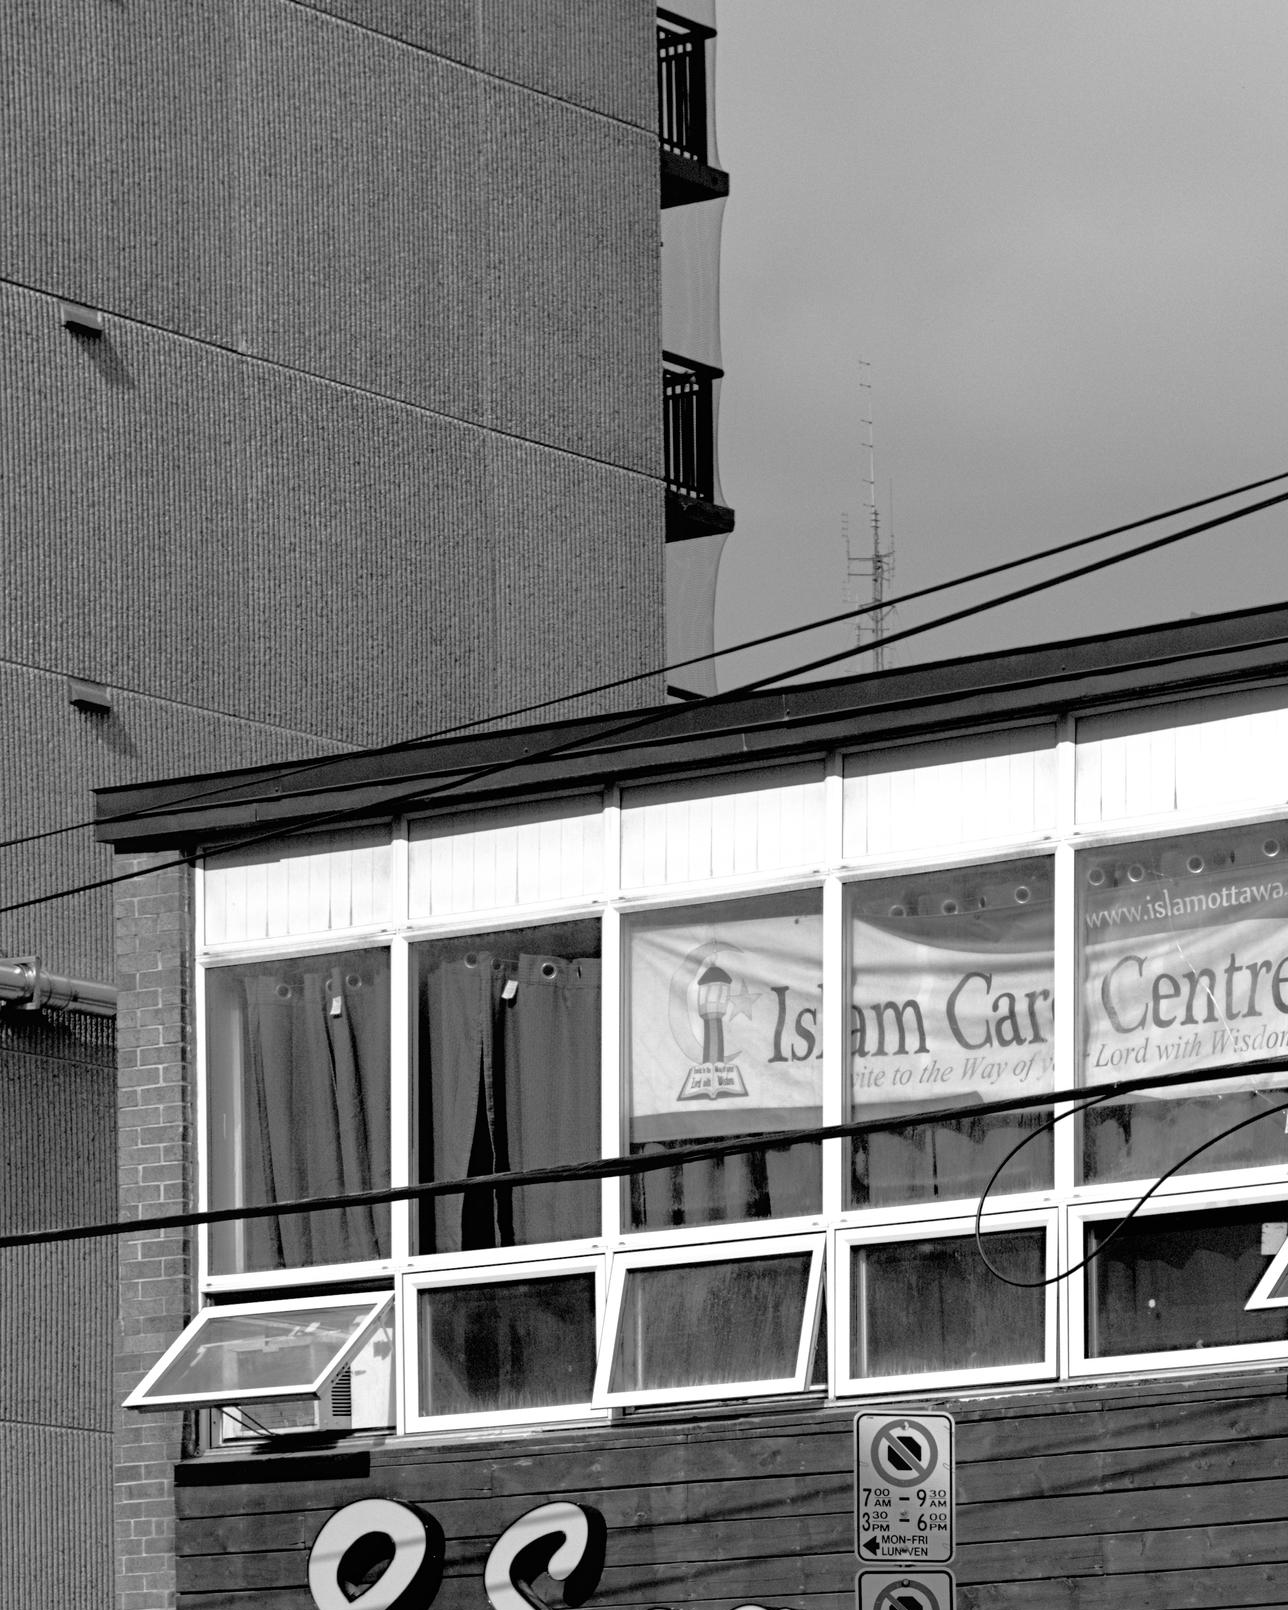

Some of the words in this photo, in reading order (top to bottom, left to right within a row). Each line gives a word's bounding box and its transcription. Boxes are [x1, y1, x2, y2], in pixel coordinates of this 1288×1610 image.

[768, 984, 930, 1063] Isam
[946, 972, 1054, 1050] Car
[892, 1066, 912, 1086] to
[919, 1060, 953, 1084] the
[961, 1056, 1008, 1086] Way
[1012, 1053, 1037, 1082] of
[1095, 1036, 1150, 1068] Lord
[1155, 1033, 1201, 1058] with
[863, 1488, 872, 1507] 7
[874, 1499, 892, 1507] AM
[916, 1489, 927, 1507] 9
[929, 1500, 947, 1508] AM
[862, 1512, 871, 1532] 3
[872, 1524, 890, 1532] PM
[917, 1513, 927, 1531] 6
[881, 1534, 928, 1544] MON-FRI
